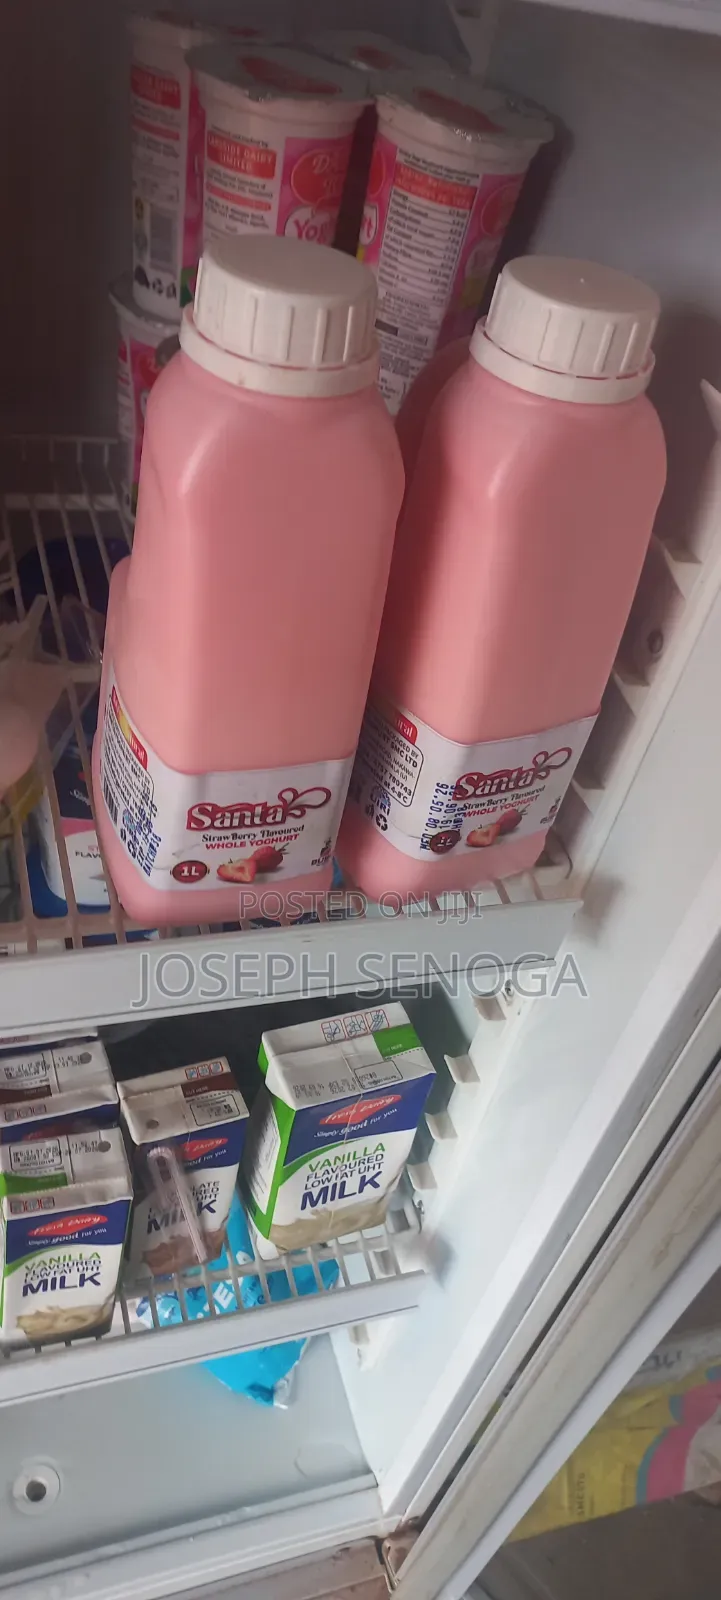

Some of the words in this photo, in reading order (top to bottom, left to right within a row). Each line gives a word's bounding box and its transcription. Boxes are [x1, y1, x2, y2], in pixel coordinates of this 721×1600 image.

[405, 754, 418, 768] LTD
[452, 767, 535, 800] Santa
[186, 802, 288, 831] Santa
[463, 806, 498, 818] WHOLE
[500, 795, 541, 811] YOGHURT
[205, 840, 247, 850] WHOLE
[249, 833, 300, 847] YOGHURT
[260, 825, 305, 839] Flavoured
[180, 866, 199, 877] 1L
[339, 1120, 368, 1136] good
[384, 1108, 398, 1119] you
[306, 1153, 384, 1182] FLAVOURED
[308, 1142, 386, 1173] VANILLA
[357, 1161, 385, 1176] UHT
[301, 1171, 383, 1210] MILK
[25, 1252, 101, 1271] VANILLA
[25, 1260, 101, 1279] FLAVOURED
[22, 1272, 101, 1297] MILK
